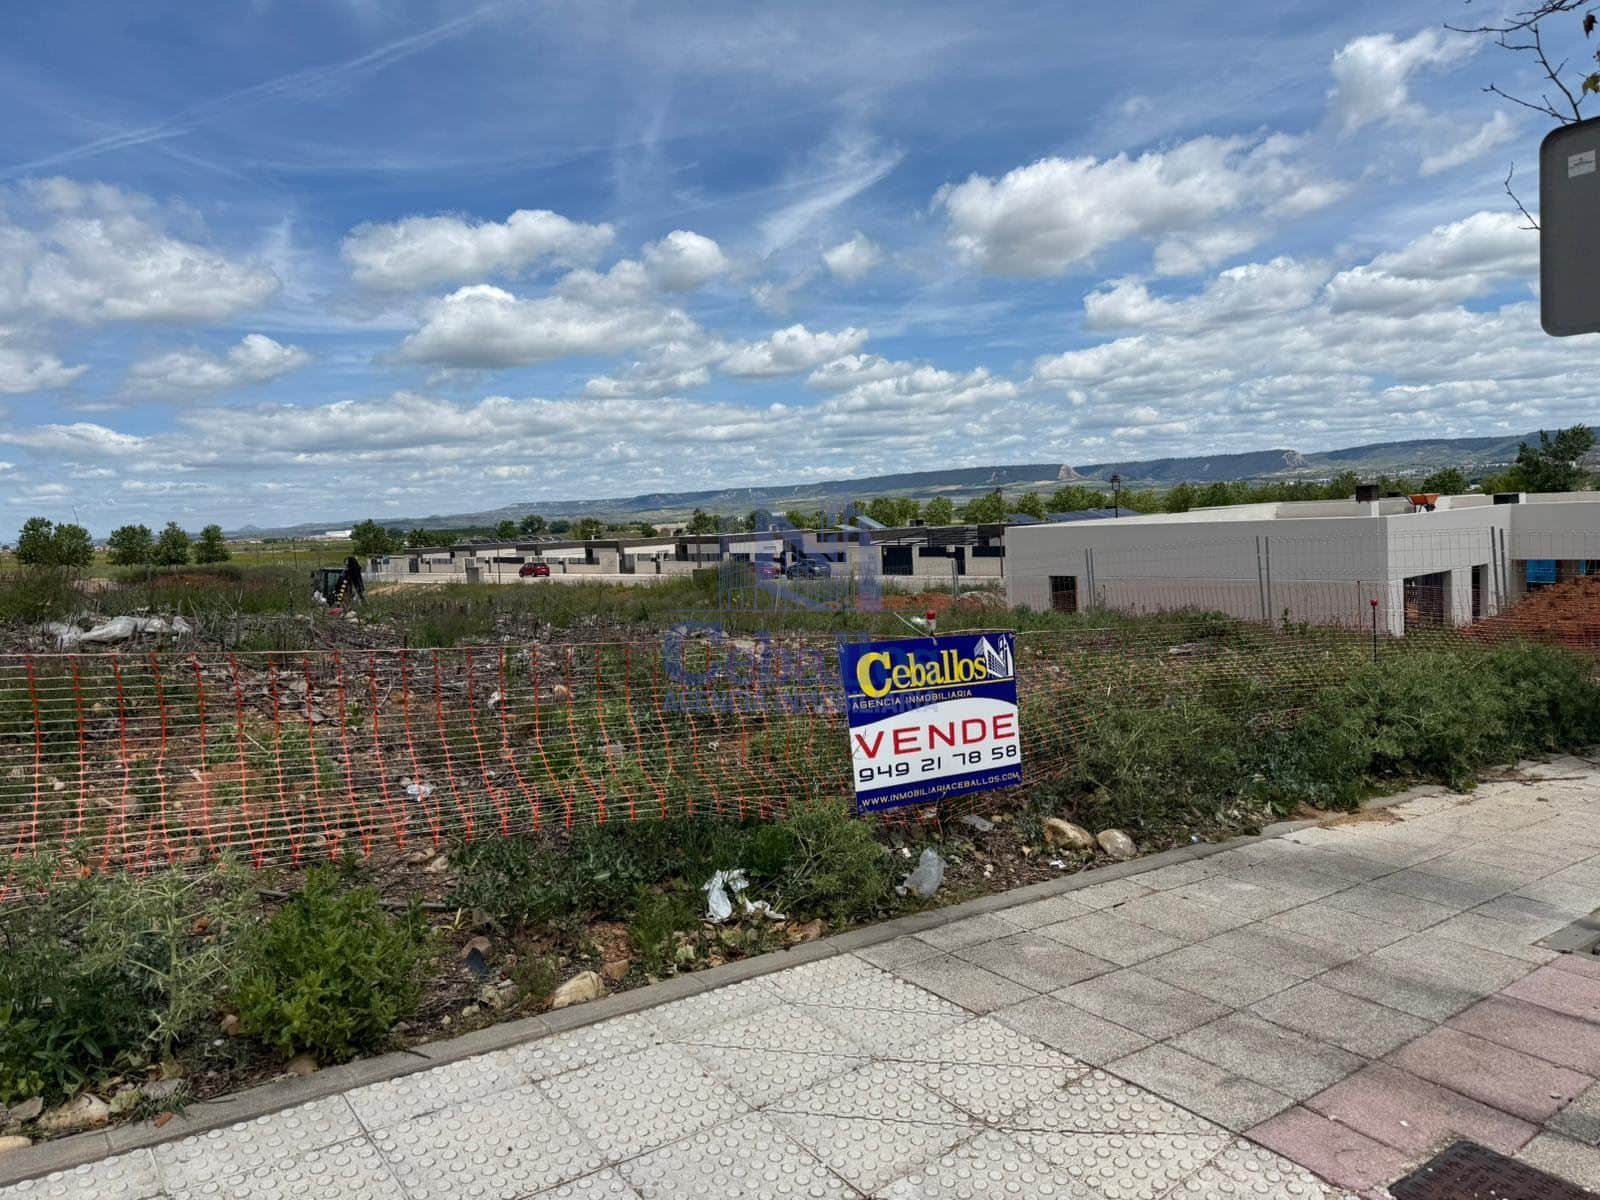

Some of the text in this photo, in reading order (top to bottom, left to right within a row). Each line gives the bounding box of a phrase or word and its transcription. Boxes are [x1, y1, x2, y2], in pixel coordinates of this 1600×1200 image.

[856, 649, 987, 698] Ceballos
[852, 689, 972, 710] AGENCIA INMOBILIARIA
[854, 713, 1016, 759] VENDE
[859, 744, 1017, 783] 949 21 78 58
[862, 771, 1020, 807] WWW.INMOBILIARIACEBALLOS.COM
